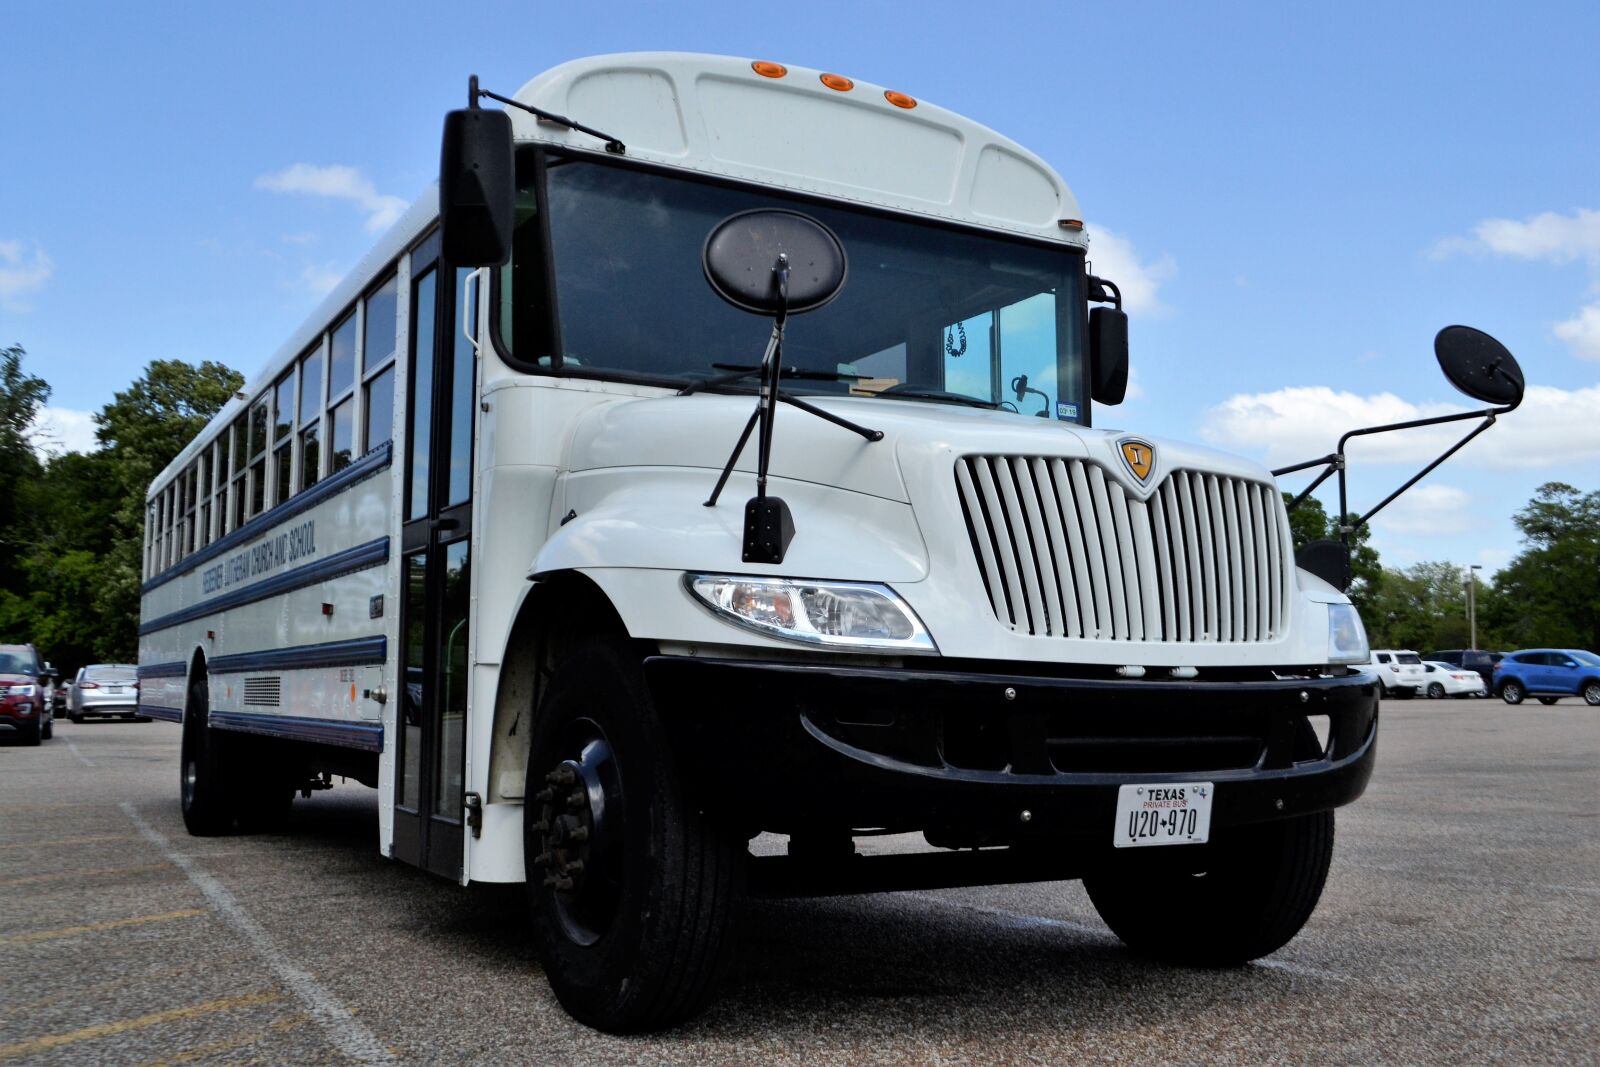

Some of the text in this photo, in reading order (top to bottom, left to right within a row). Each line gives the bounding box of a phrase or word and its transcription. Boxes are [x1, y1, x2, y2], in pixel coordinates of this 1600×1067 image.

[251, 539, 274, 577] CHURCH
[274, 533, 288, 568] AND
[289, 520, 316, 562] SCHOOL
[1147, 788, 1186, 801] TEXAS
[1142, 799, 1188, 809] PRIVATE BUS
